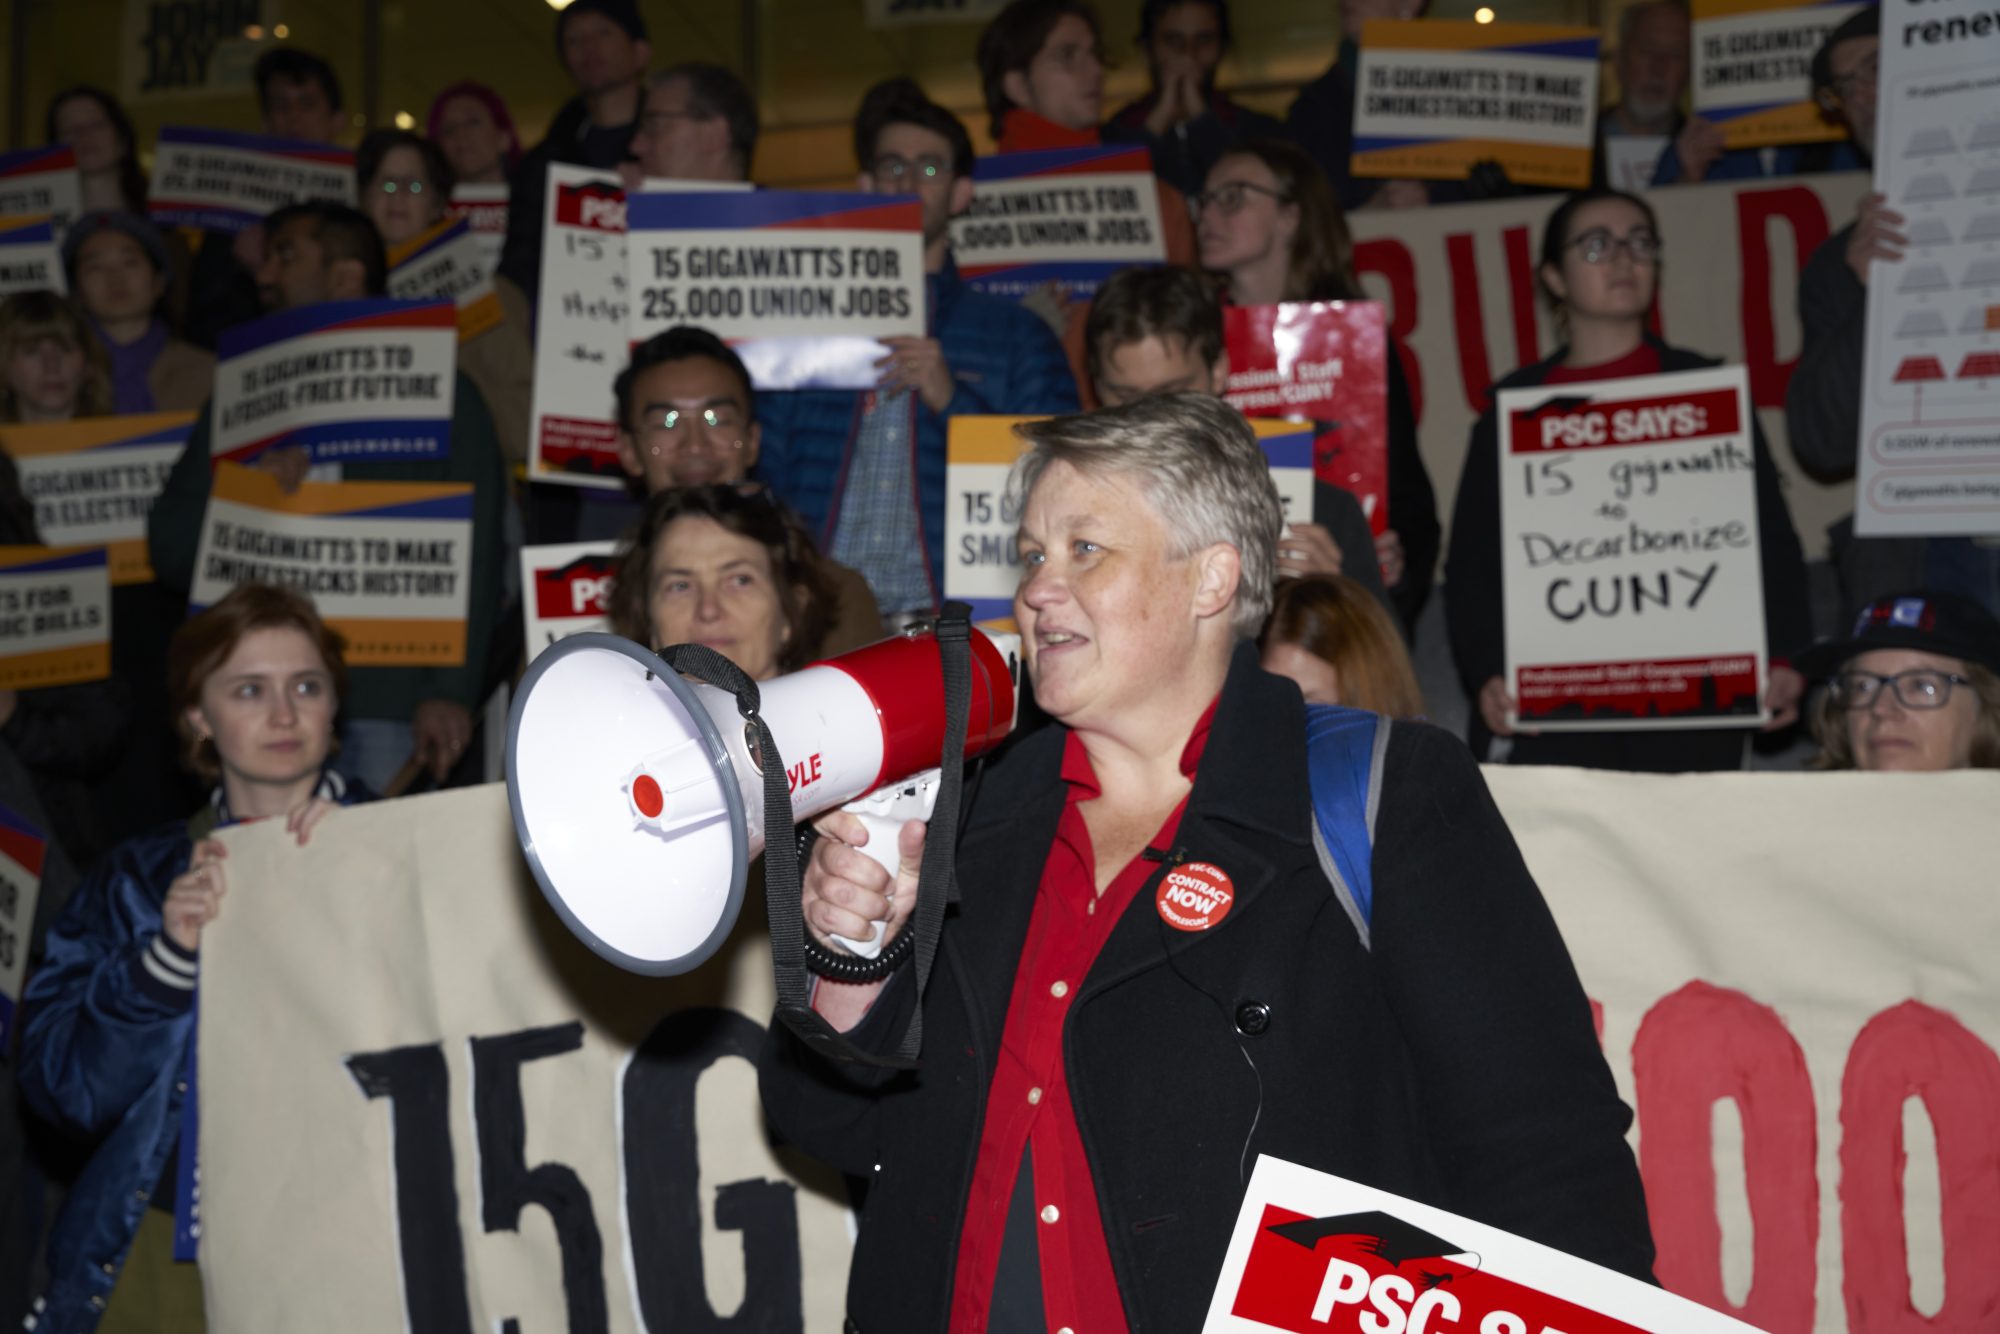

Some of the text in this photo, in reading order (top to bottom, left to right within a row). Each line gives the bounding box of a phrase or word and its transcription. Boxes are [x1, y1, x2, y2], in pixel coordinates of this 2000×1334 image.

[650, 246, 901, 280] 15 GIGAWATTS FOR
[641, 285, 912, 323] 25,000 UNION JOBS
[381, 344, 414, 371] TO
[351, 373, 443, 401] FUTURE
[1541, 402, 1709, 448] PSC SAYS:
[1523, 453, 1575, 498] 15
[961, 490, 992, 526] 15
[235, 526, 357, 566] GIGAWATTS
[361, 537, 390, 566] TO
[395, 539, 458, 568] MAKE
[1520, 518, 1752, 567] Decarbonize
[27, 584, 71, 611] FOR
[361, 569, 459, 598] HISTORY
[1546, 562, 1719, 623] CUNY
[34, 604, 103, 636] BILLS
[1165, 884, 1218, 915] NOW
[1166, 872, 1232, 905] CONTRACT
